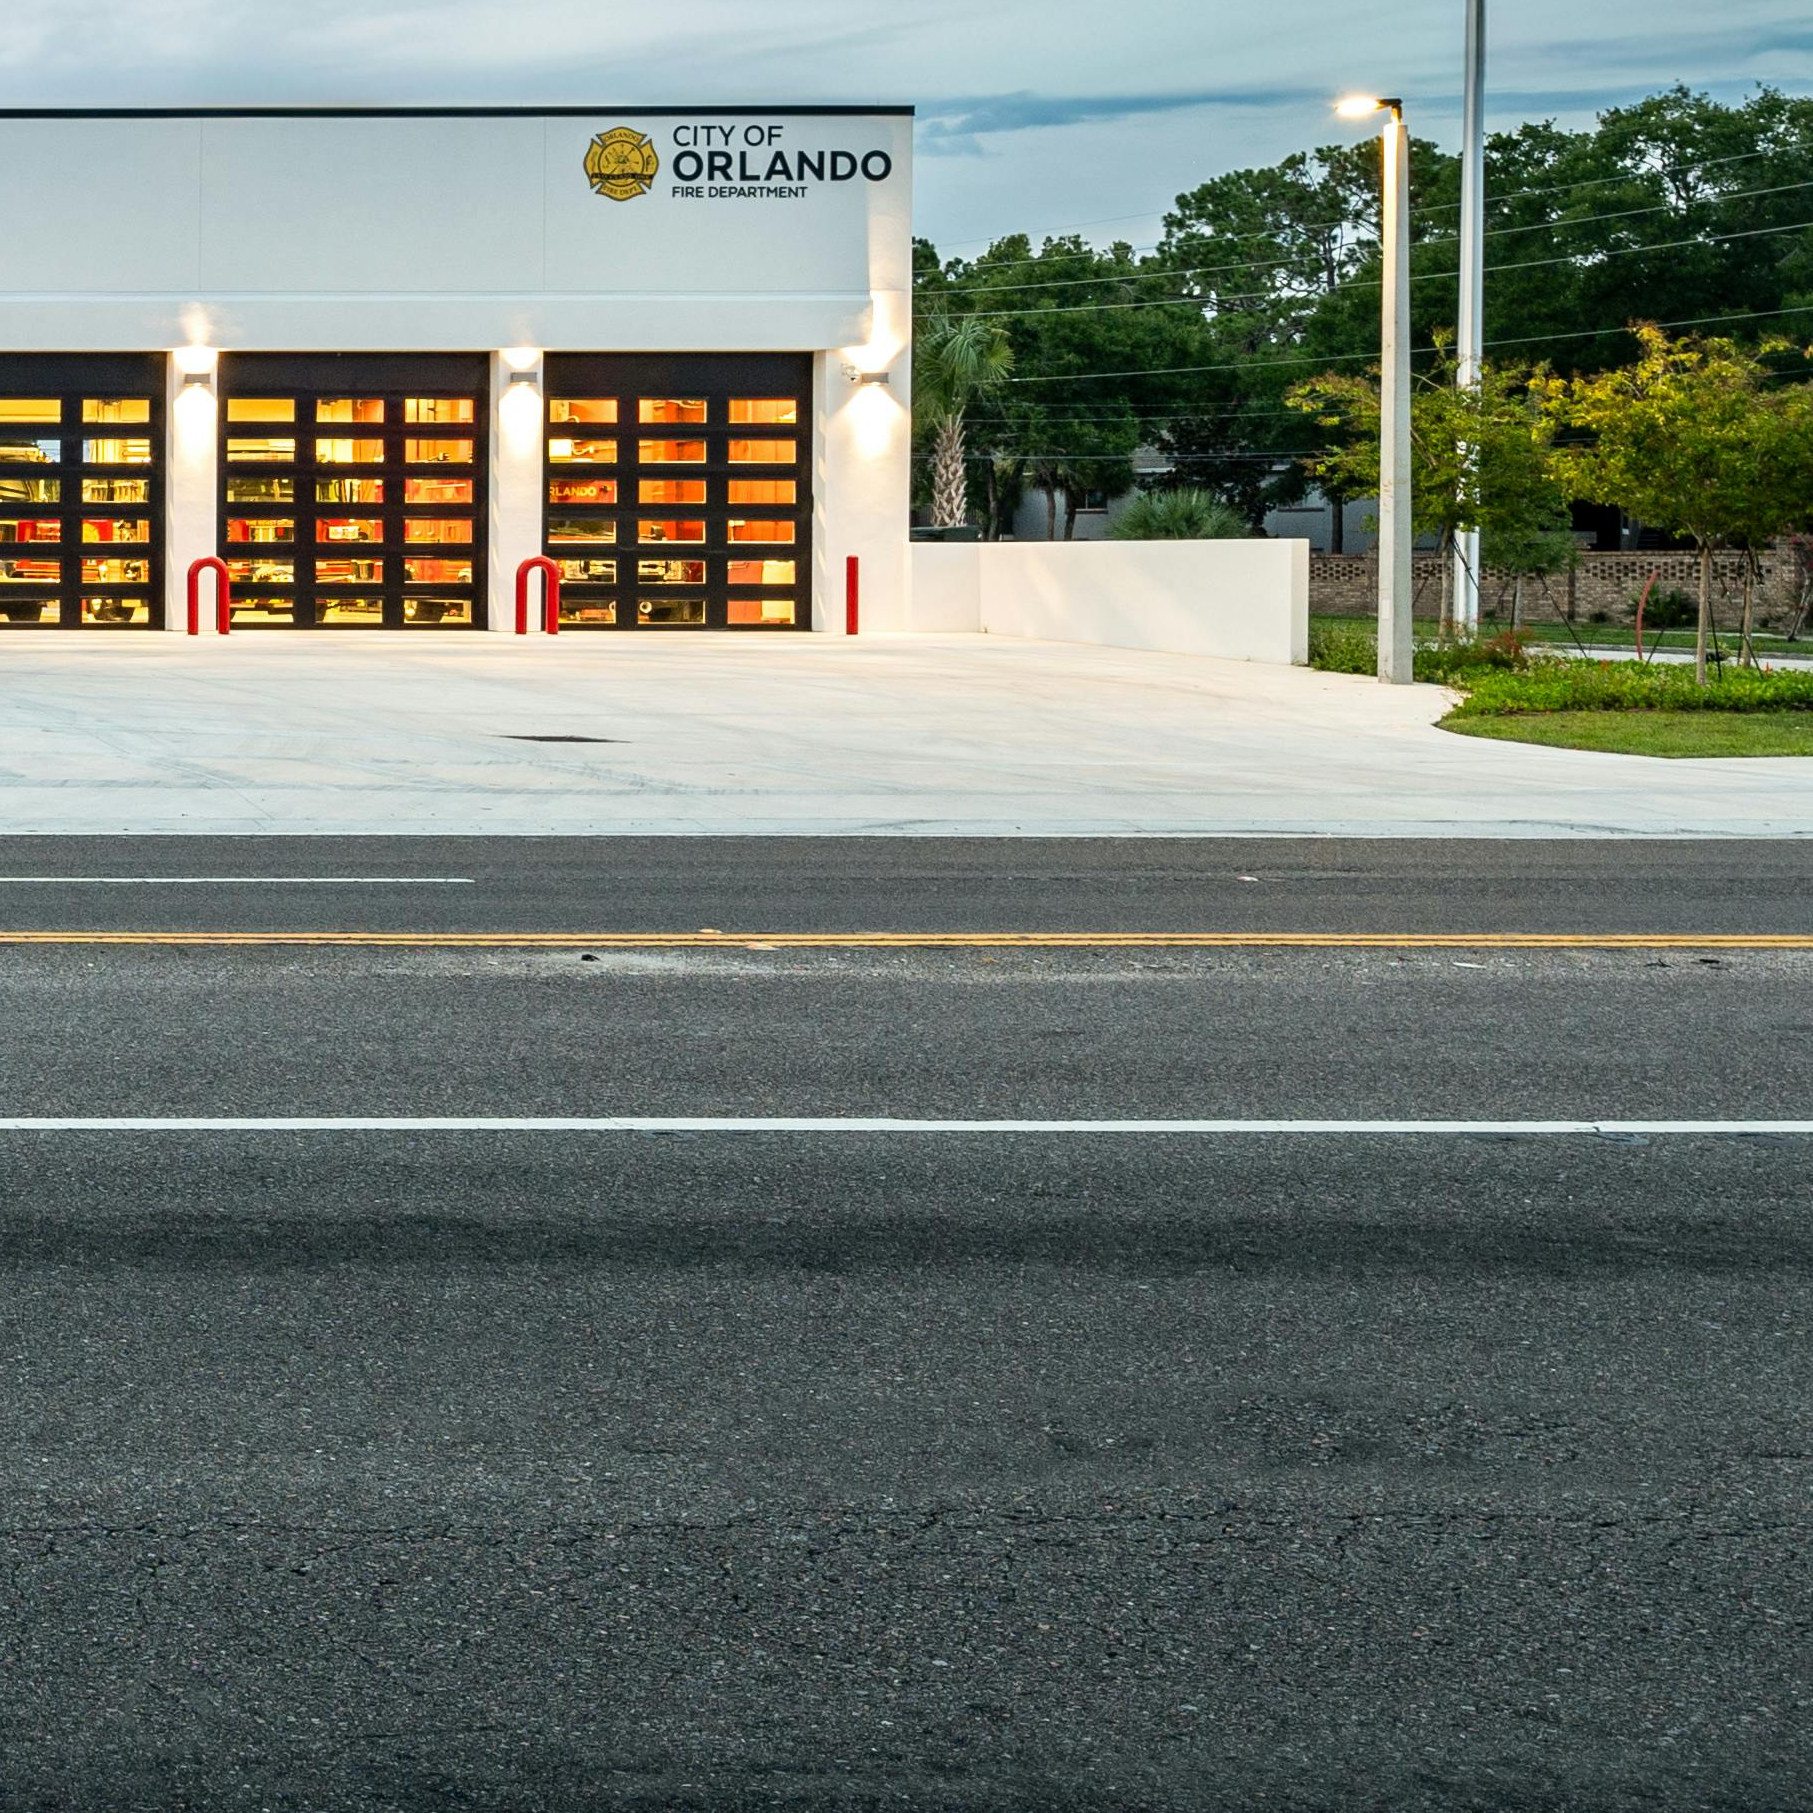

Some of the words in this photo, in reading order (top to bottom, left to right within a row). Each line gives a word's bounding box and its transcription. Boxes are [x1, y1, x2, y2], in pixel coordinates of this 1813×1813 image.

[673, 125, 736, 147] CITY
[744, 125, 784, 147] OF
[672, 150, 892, 182] ORLANDO
[672, 186, 705, 198] FIRE
[708, 186, 808, 198] DEPARTMENT
